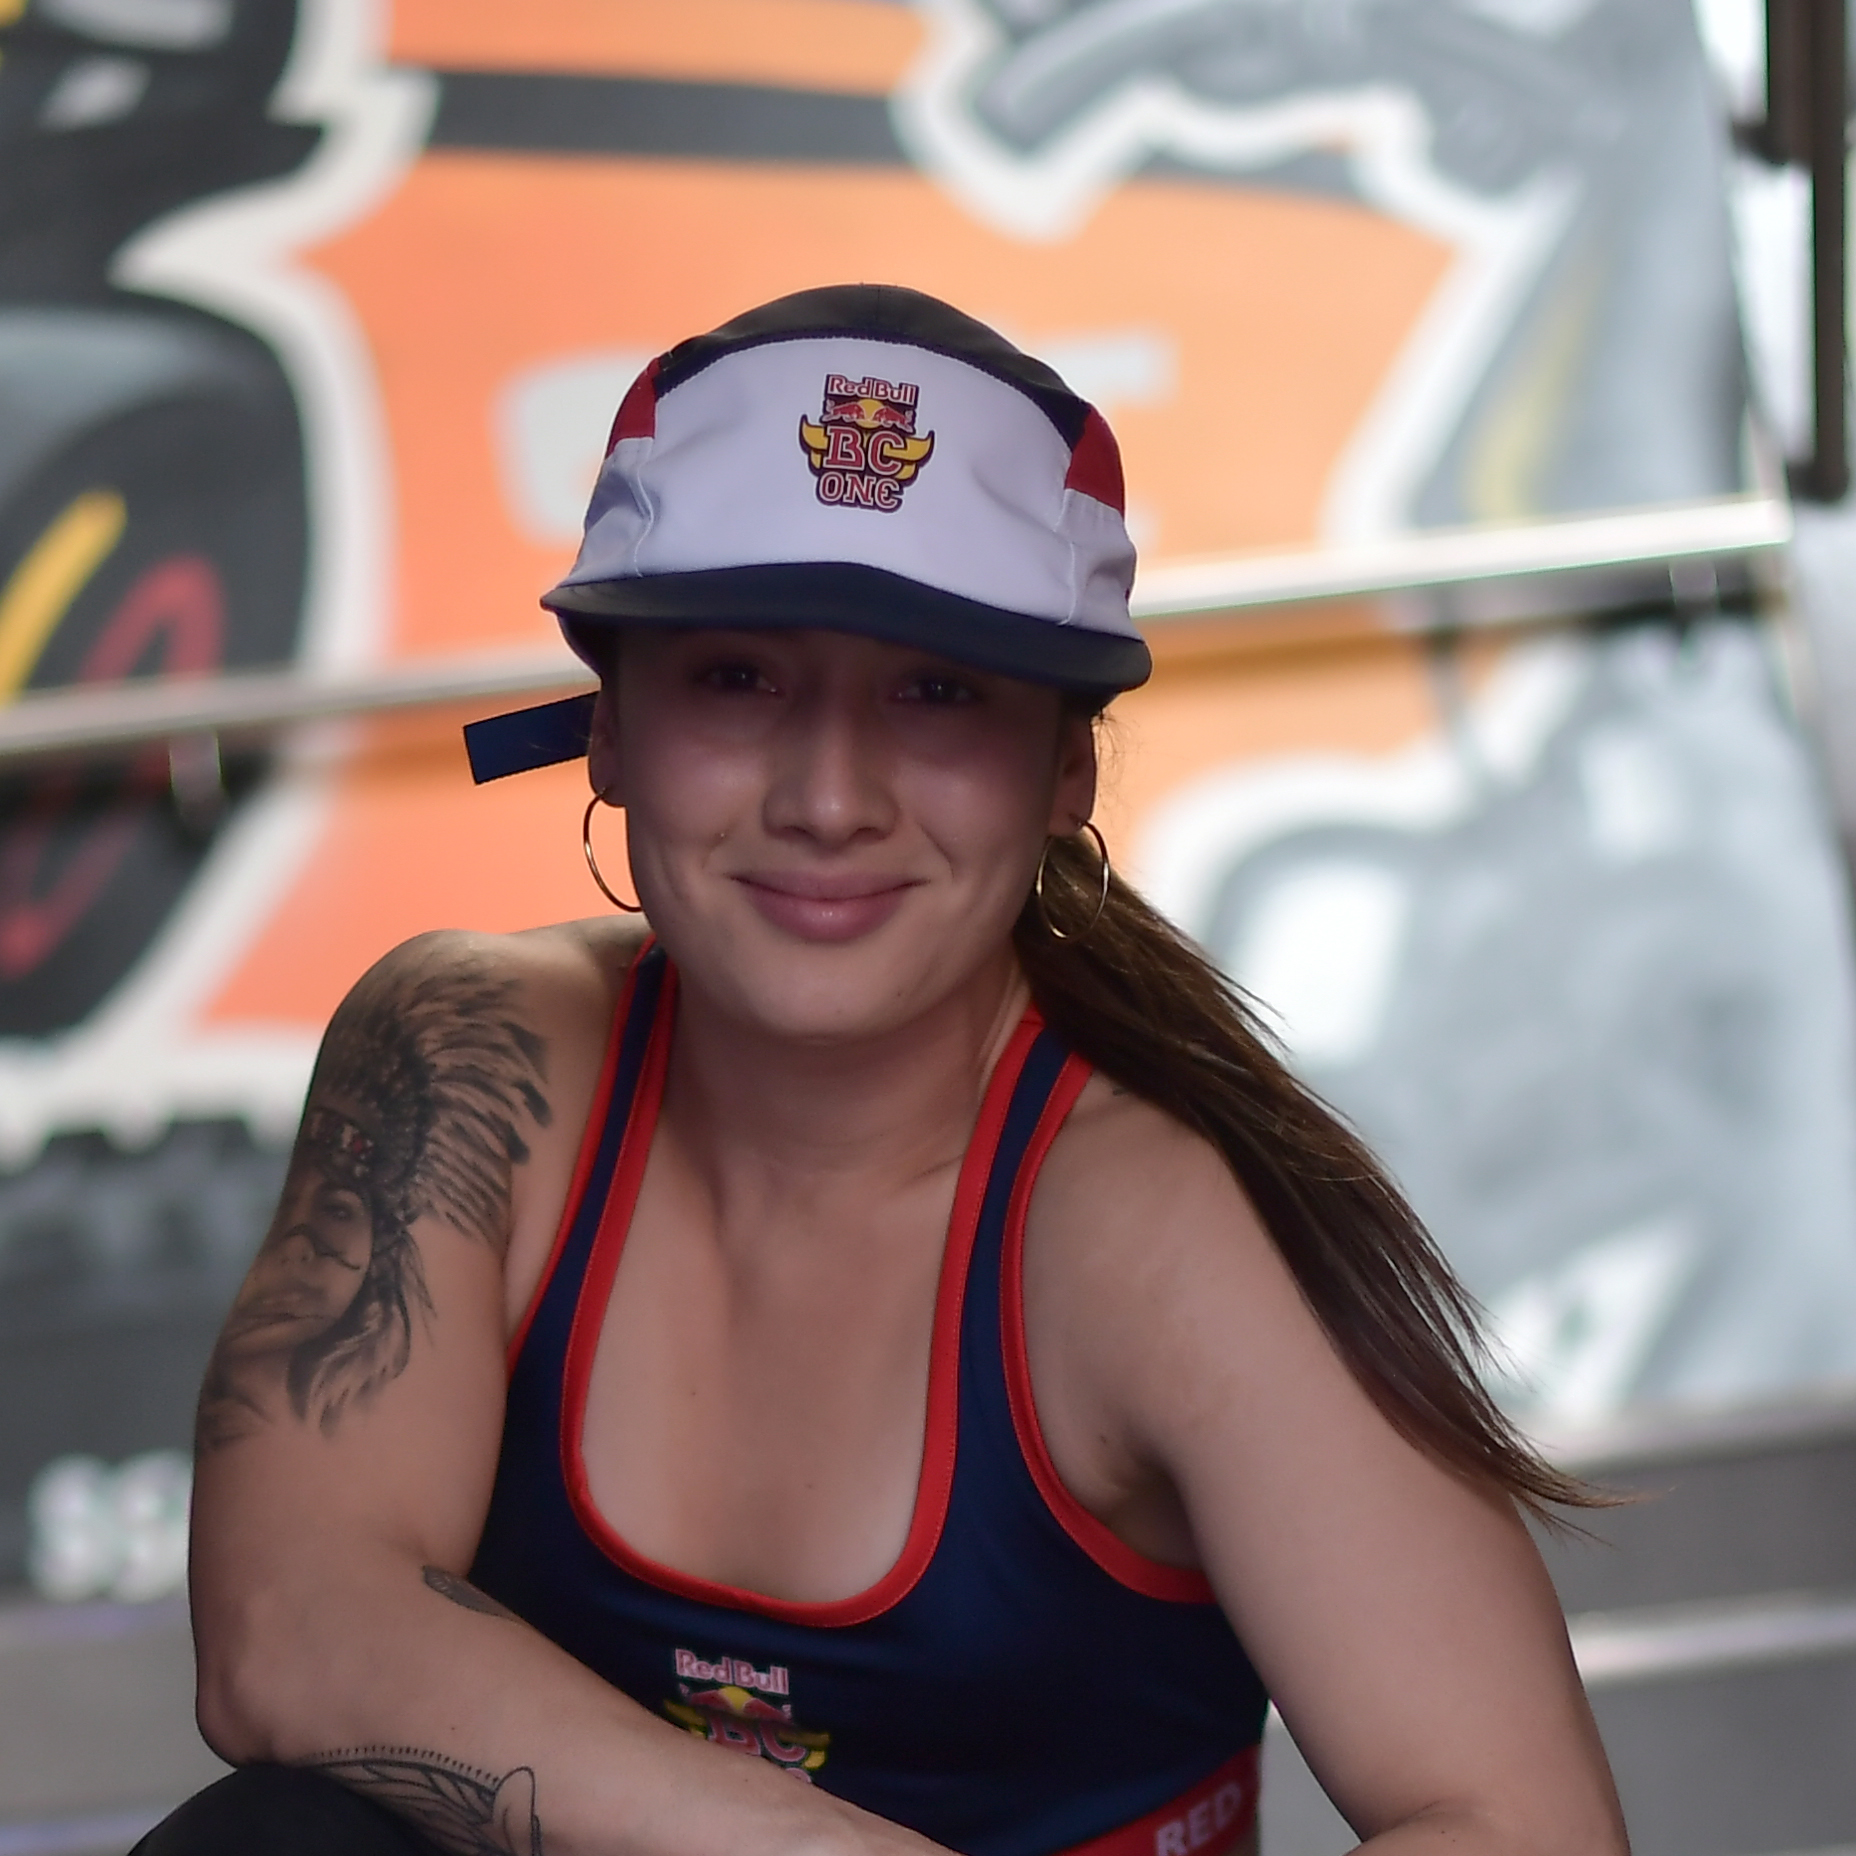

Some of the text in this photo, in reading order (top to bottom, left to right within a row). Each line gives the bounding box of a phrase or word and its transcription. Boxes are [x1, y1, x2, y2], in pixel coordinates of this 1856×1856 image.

[828, 374, 916, 405] Red Bull
[824, 427, 904, 475] BC
[821, 472, 900, 509] ONE
[675, 1648, 789, 1695] Red Bull
